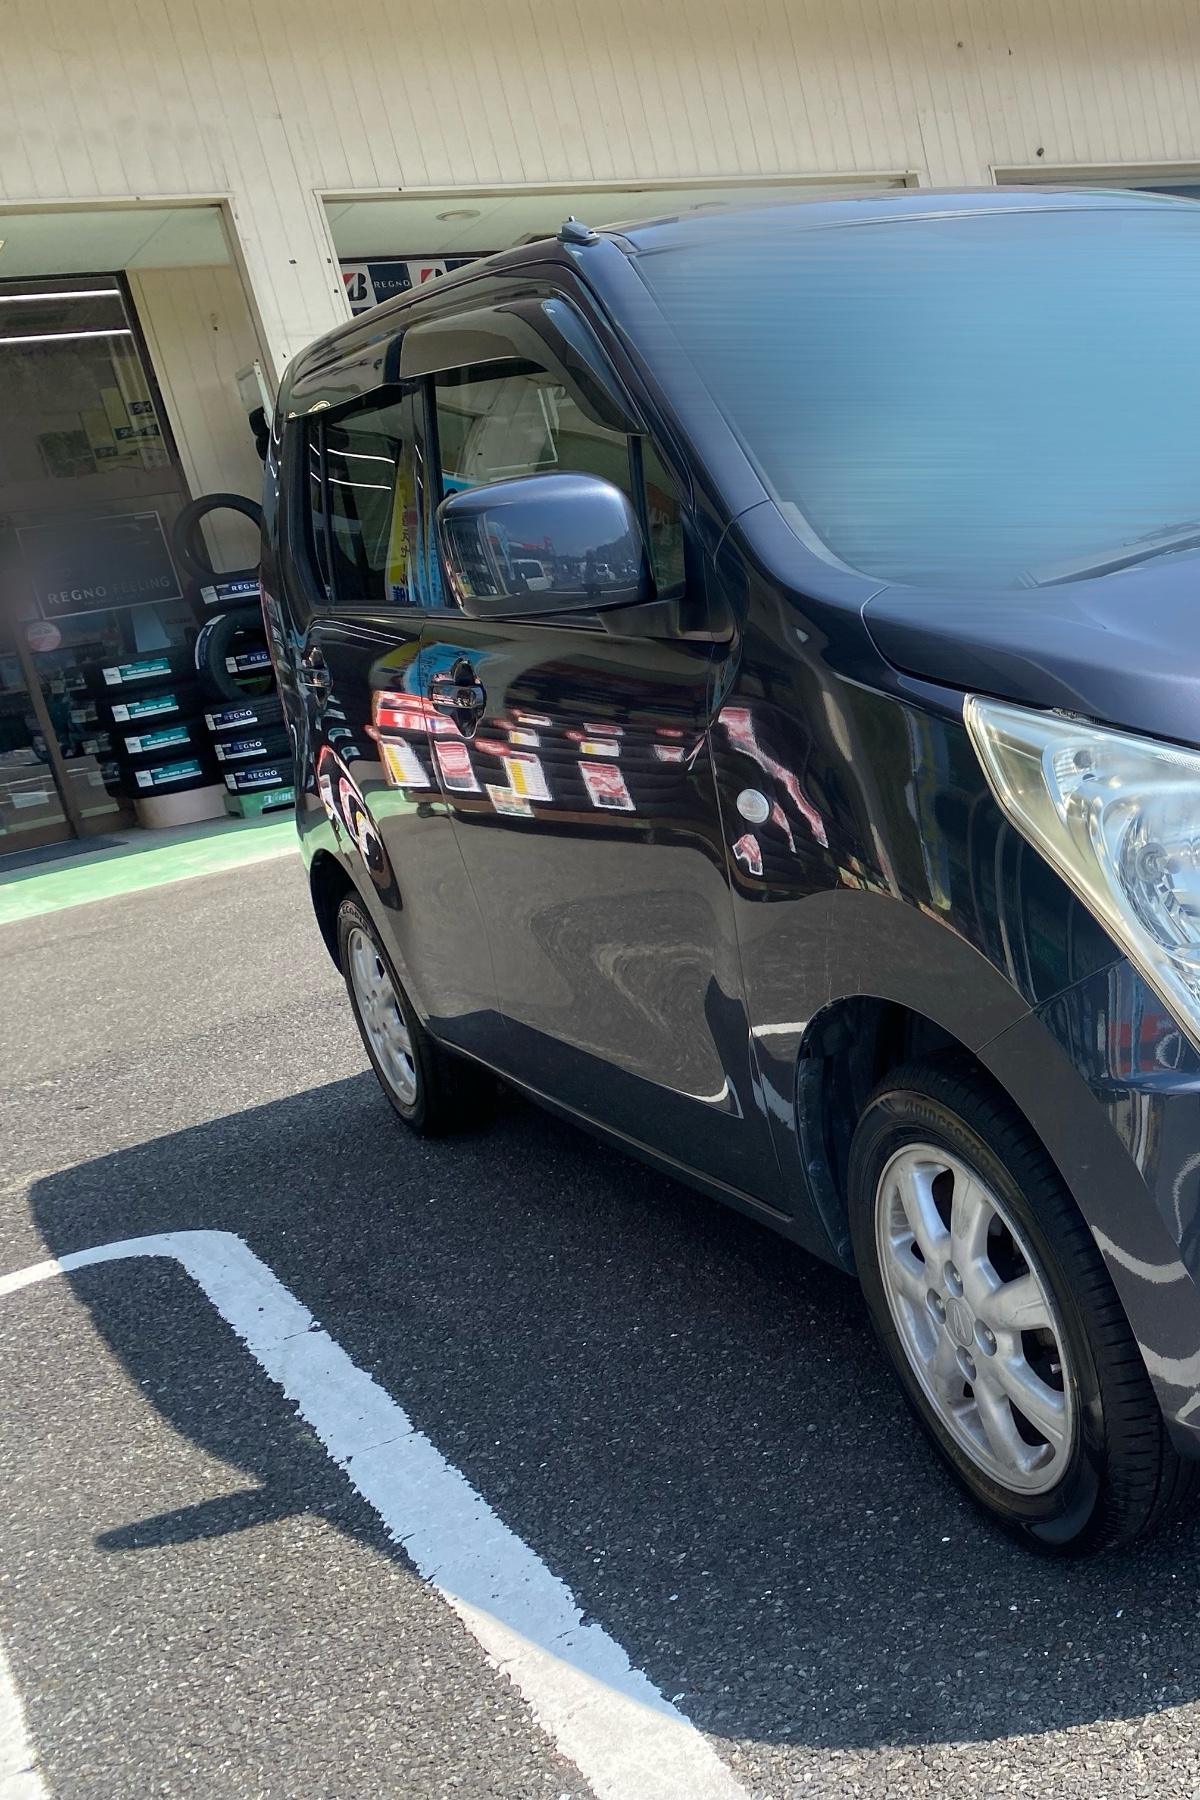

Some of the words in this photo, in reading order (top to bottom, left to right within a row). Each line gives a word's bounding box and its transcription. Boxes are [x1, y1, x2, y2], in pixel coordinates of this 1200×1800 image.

[373, 279, 411, 289] REGNO
[47, 585, 107, 605] REGNO
[111, 576, 170, 596] FEELING
[250, 653, 269, 662] REG
[223, 709, 253, 721] REGNO
[233, 741, 262, 751] REGNO
[247, 769, 278, 779] REGNO
